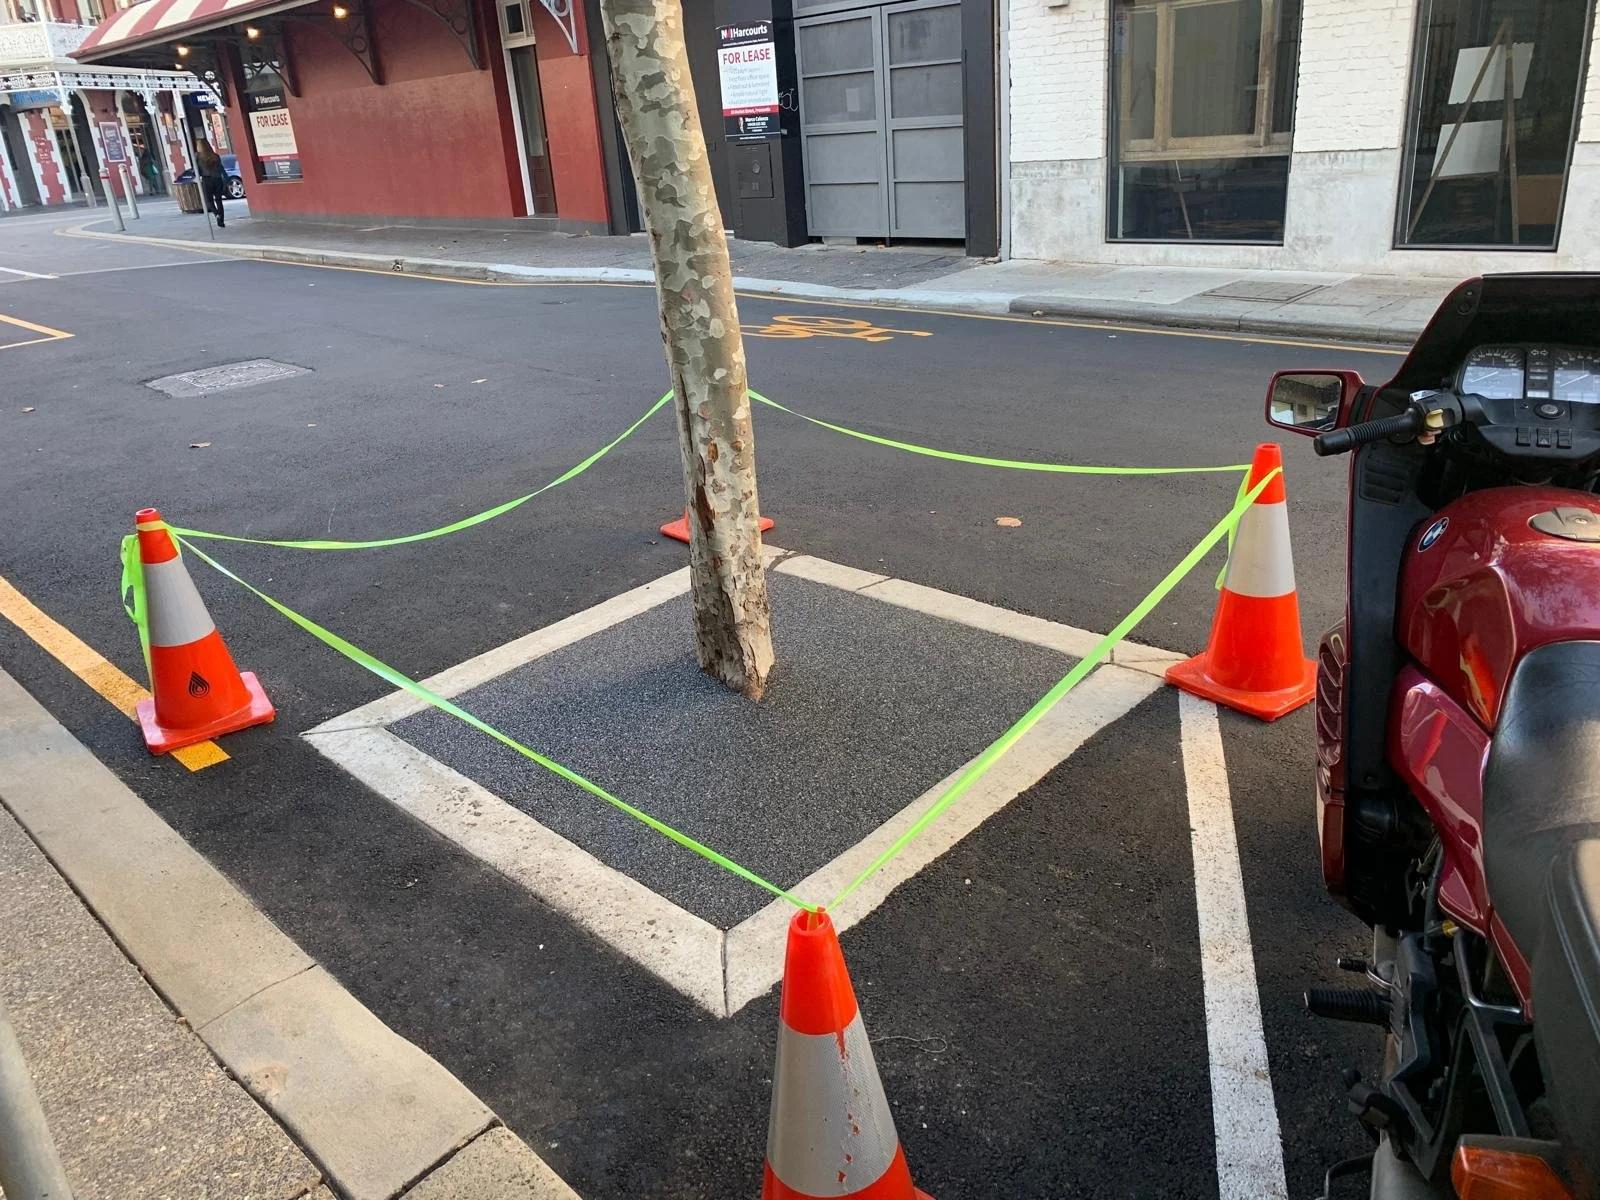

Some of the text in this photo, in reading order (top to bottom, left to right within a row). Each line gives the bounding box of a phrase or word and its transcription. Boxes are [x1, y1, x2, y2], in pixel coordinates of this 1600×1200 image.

[733, 24, 768, 38] Harcourts
[723, 48, 771, 64] FOR LEASE
[256, 113, 288, 127] FOR LEASE
